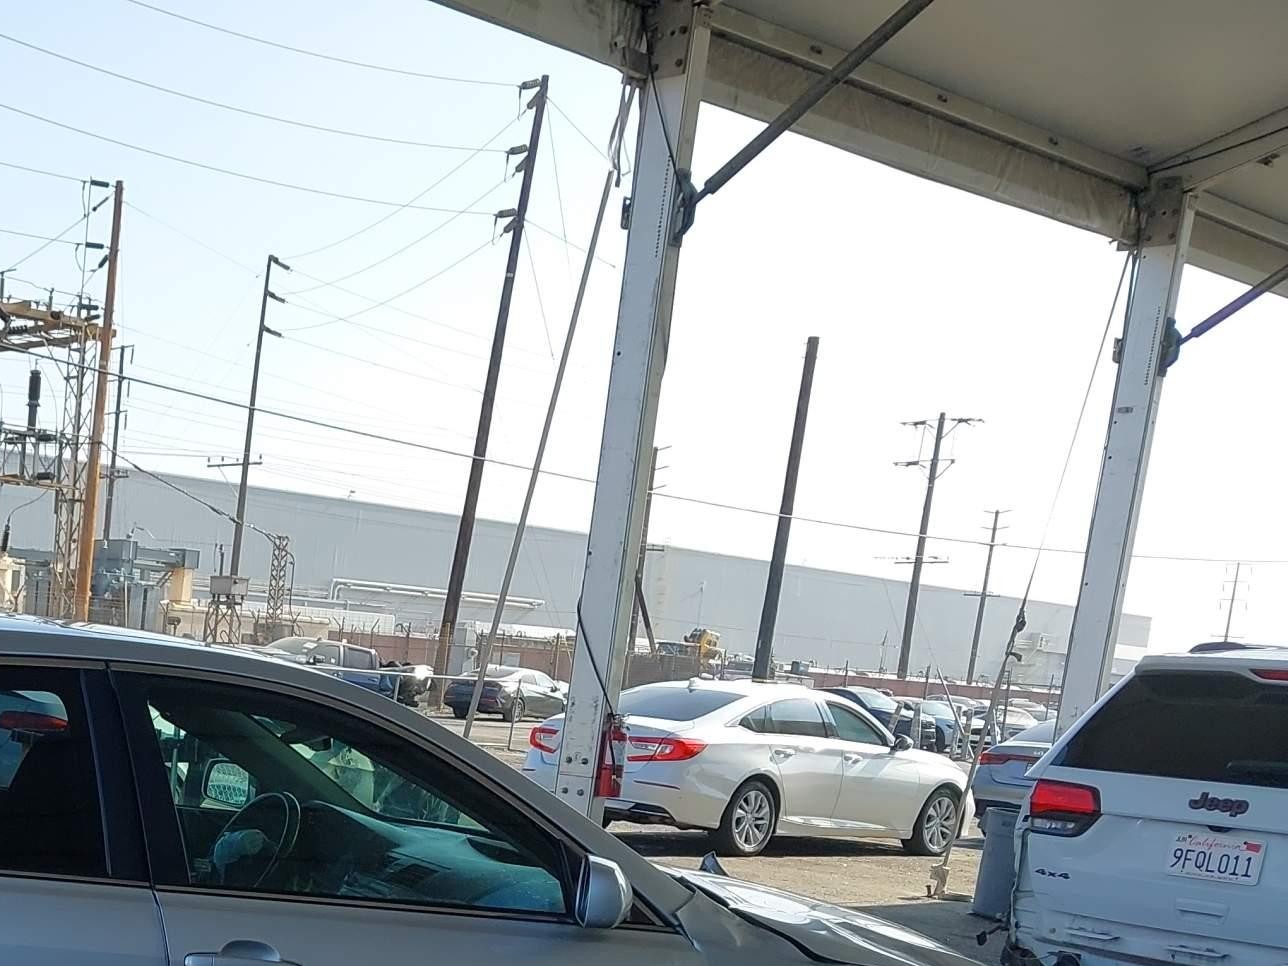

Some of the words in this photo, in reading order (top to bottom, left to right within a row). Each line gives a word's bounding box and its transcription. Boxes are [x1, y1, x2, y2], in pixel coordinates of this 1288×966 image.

[1188, 792, 1250, 818] Jeep
[1187, 836, 1242, 850] California
[1170, 848, 1253, 878] 9FQL011
